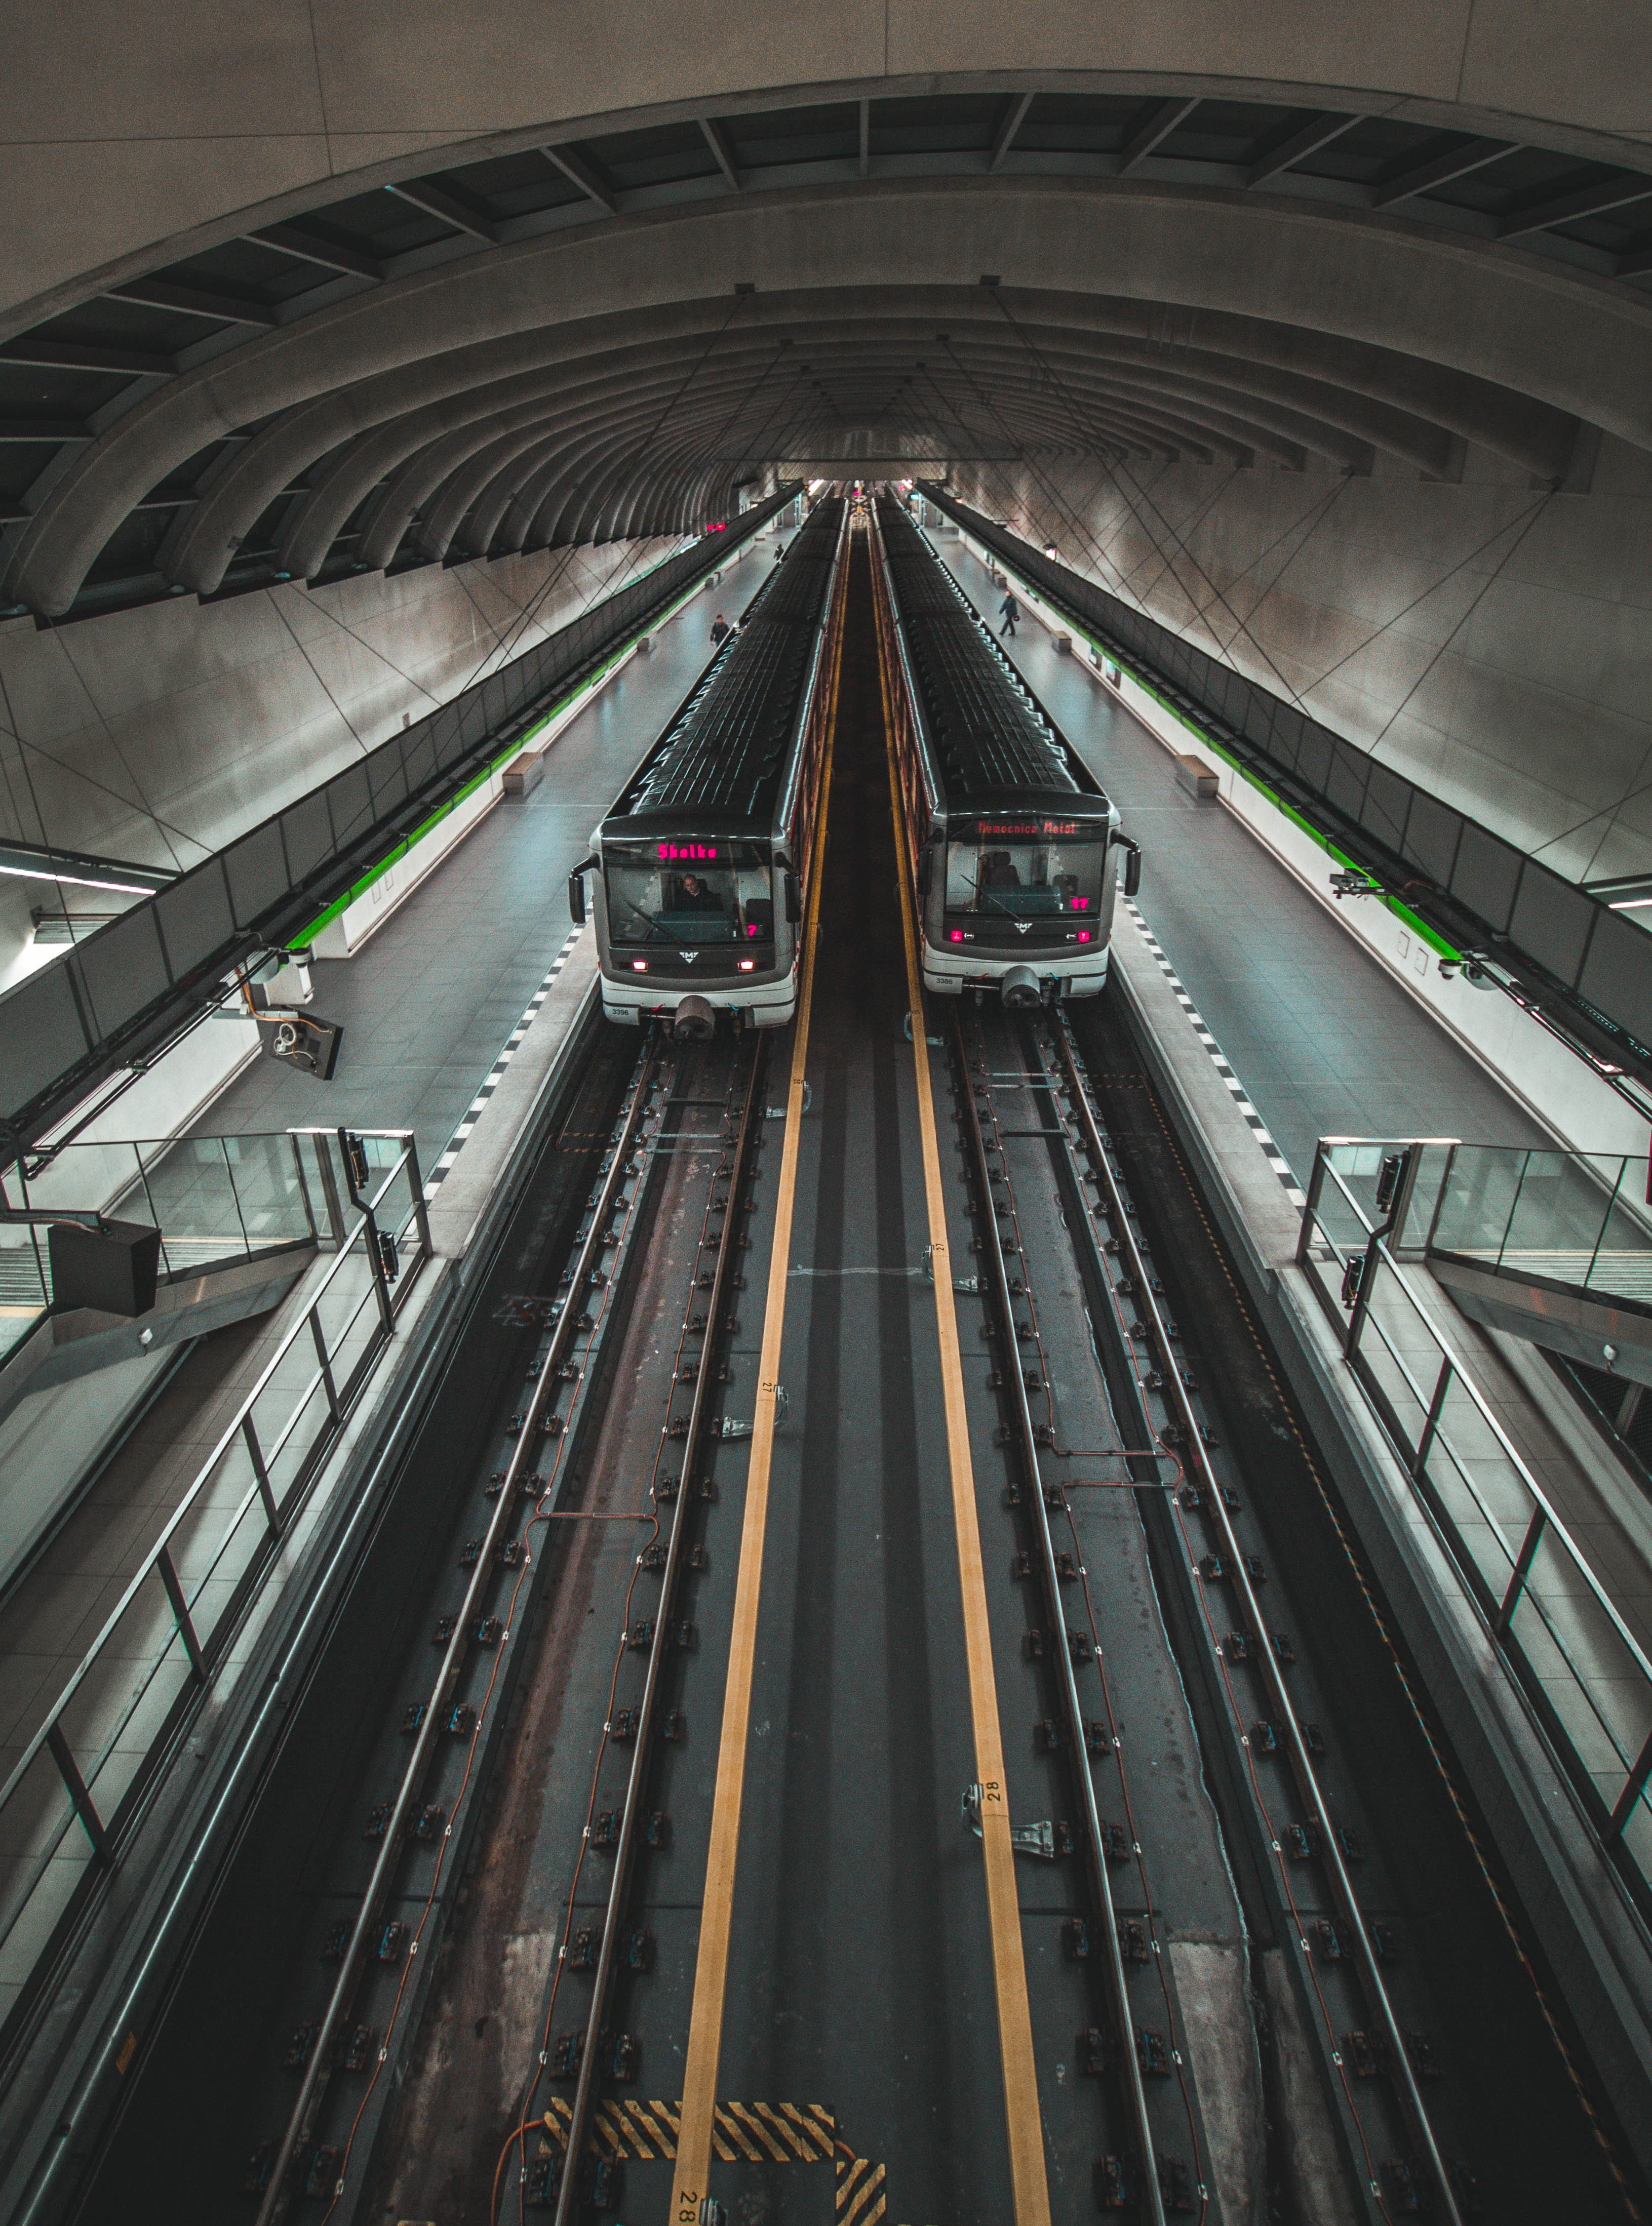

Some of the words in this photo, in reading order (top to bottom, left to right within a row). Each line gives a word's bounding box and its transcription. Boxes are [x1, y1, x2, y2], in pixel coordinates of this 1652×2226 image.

[747, 924, 757, 936] 7
[763, 1382, 772, 1393] 27
[986, 1782, 1000, 1802] 28
[680, 2191, 698, 2222] 28
